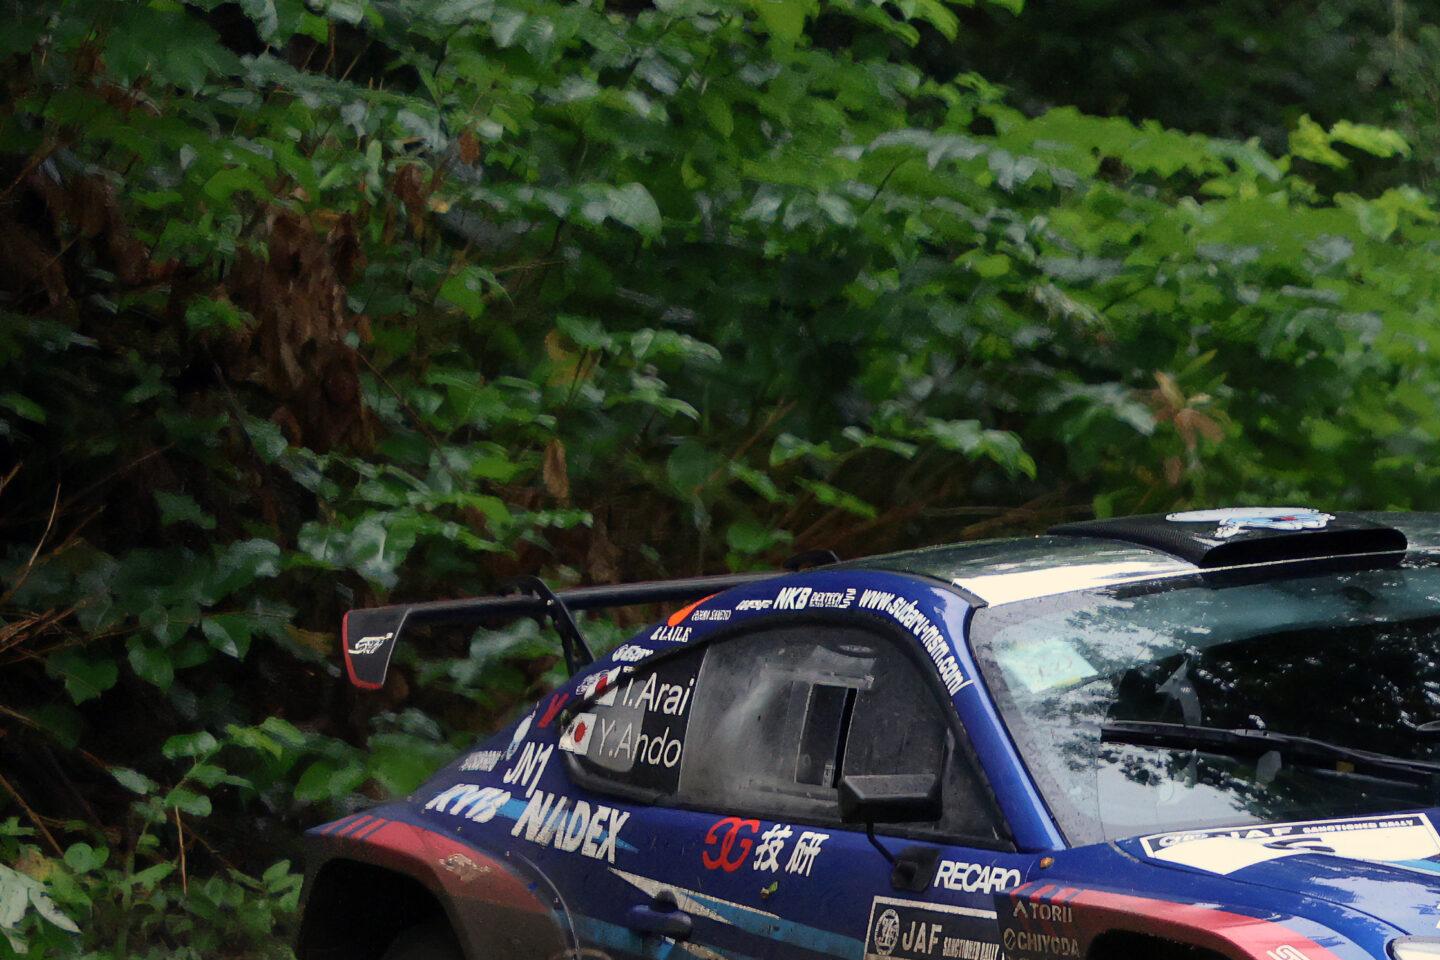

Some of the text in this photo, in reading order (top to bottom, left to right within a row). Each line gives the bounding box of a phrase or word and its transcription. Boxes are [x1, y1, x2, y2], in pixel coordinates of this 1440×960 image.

[599, 718, 682, 768] Y.Ando
[503, 742, 554, 798] JN1
[753, 823, 829, 877] 技研
[902, 920, 942, 955] JAF
[1029, 902, 1073, 923] TORII
